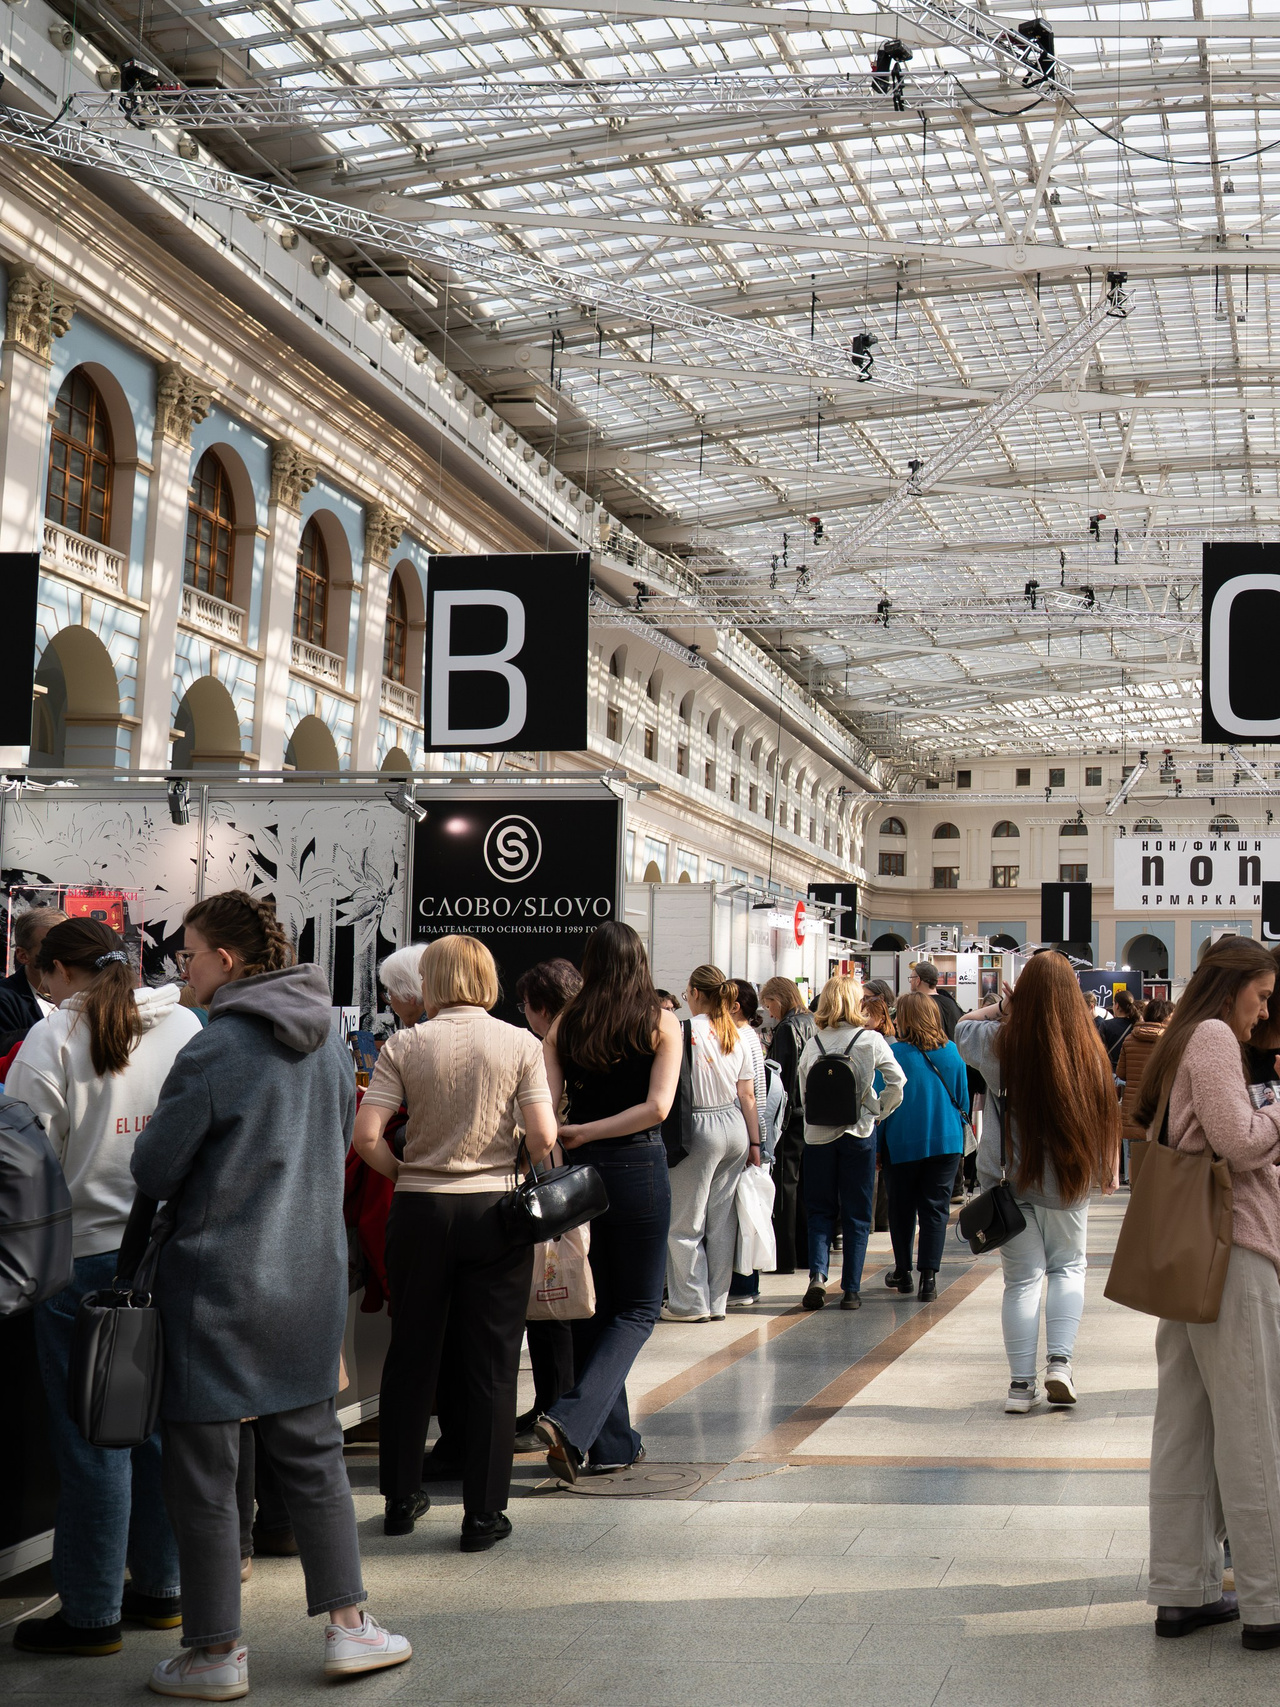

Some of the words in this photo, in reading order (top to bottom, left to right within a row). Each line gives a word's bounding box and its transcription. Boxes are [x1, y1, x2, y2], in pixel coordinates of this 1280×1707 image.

[431, 590, 527, 745] B
[1142, 841, 1262, 851] НОН/ФИКШН
[1142, 895, 1236, 905] ЯРМАРКА
[419, 925, 494, 933] ИЗДАТЕЛЬСТВО
[497, 925, 554, 933] ОСНОВАНО
[116, 1117, 131, 1134] EL
